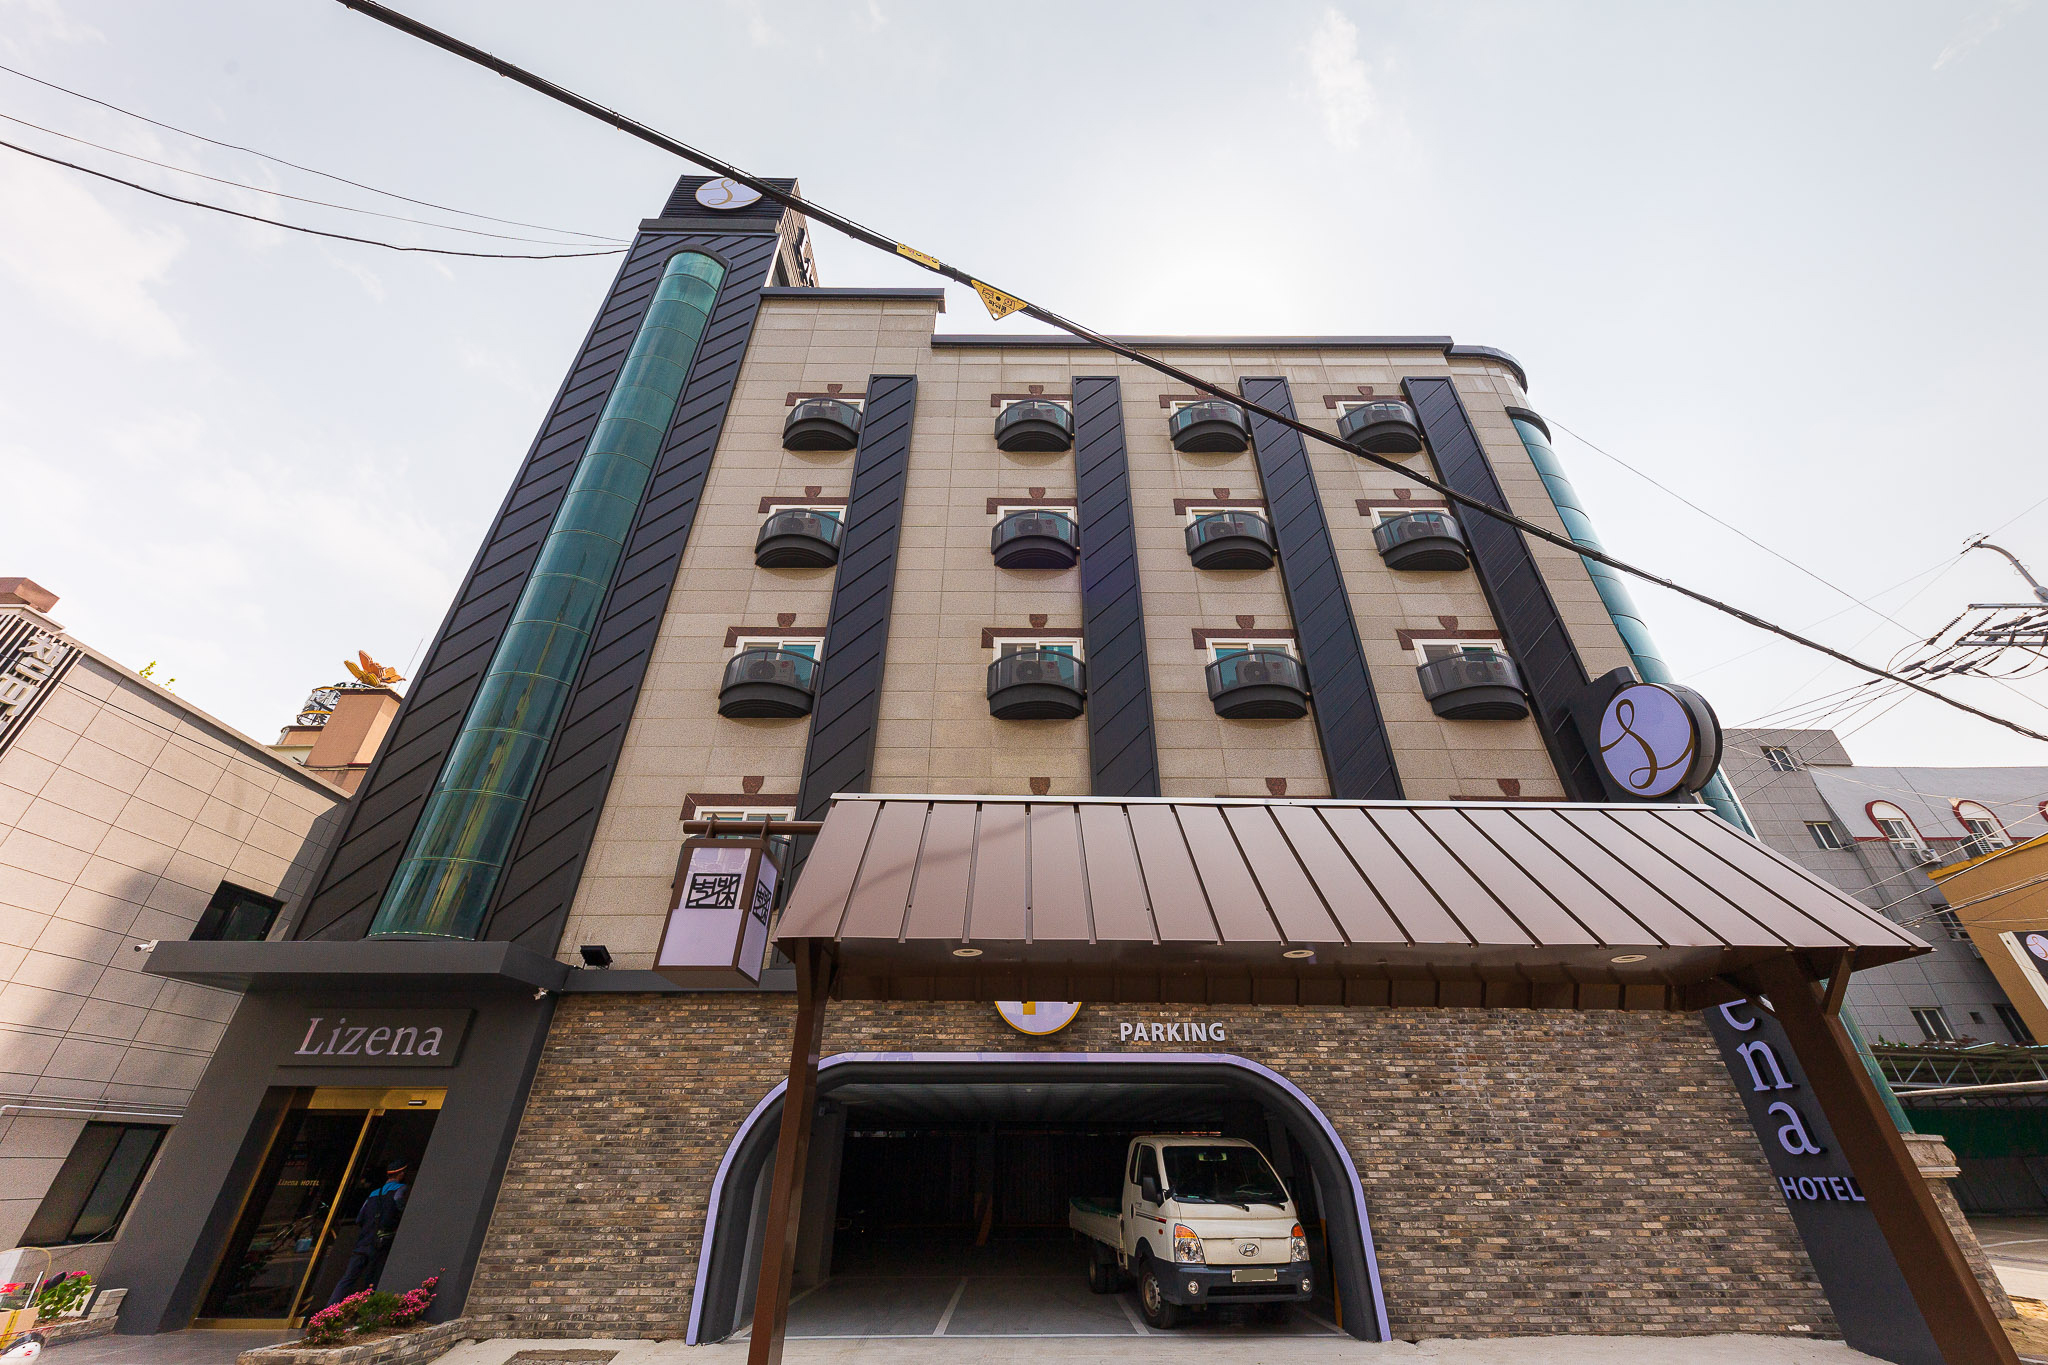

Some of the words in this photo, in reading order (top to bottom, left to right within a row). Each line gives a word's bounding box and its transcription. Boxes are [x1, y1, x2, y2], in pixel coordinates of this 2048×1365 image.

[0, 634, 70, 737] 챔피
[294, 1017, 443, 1056] Lizena
[1120, 1022, 1226, 1042] PARKING
[300, 1179, 320, 1187] HOTEL
[1778, 1176, 1867, 1202] HOTEL
